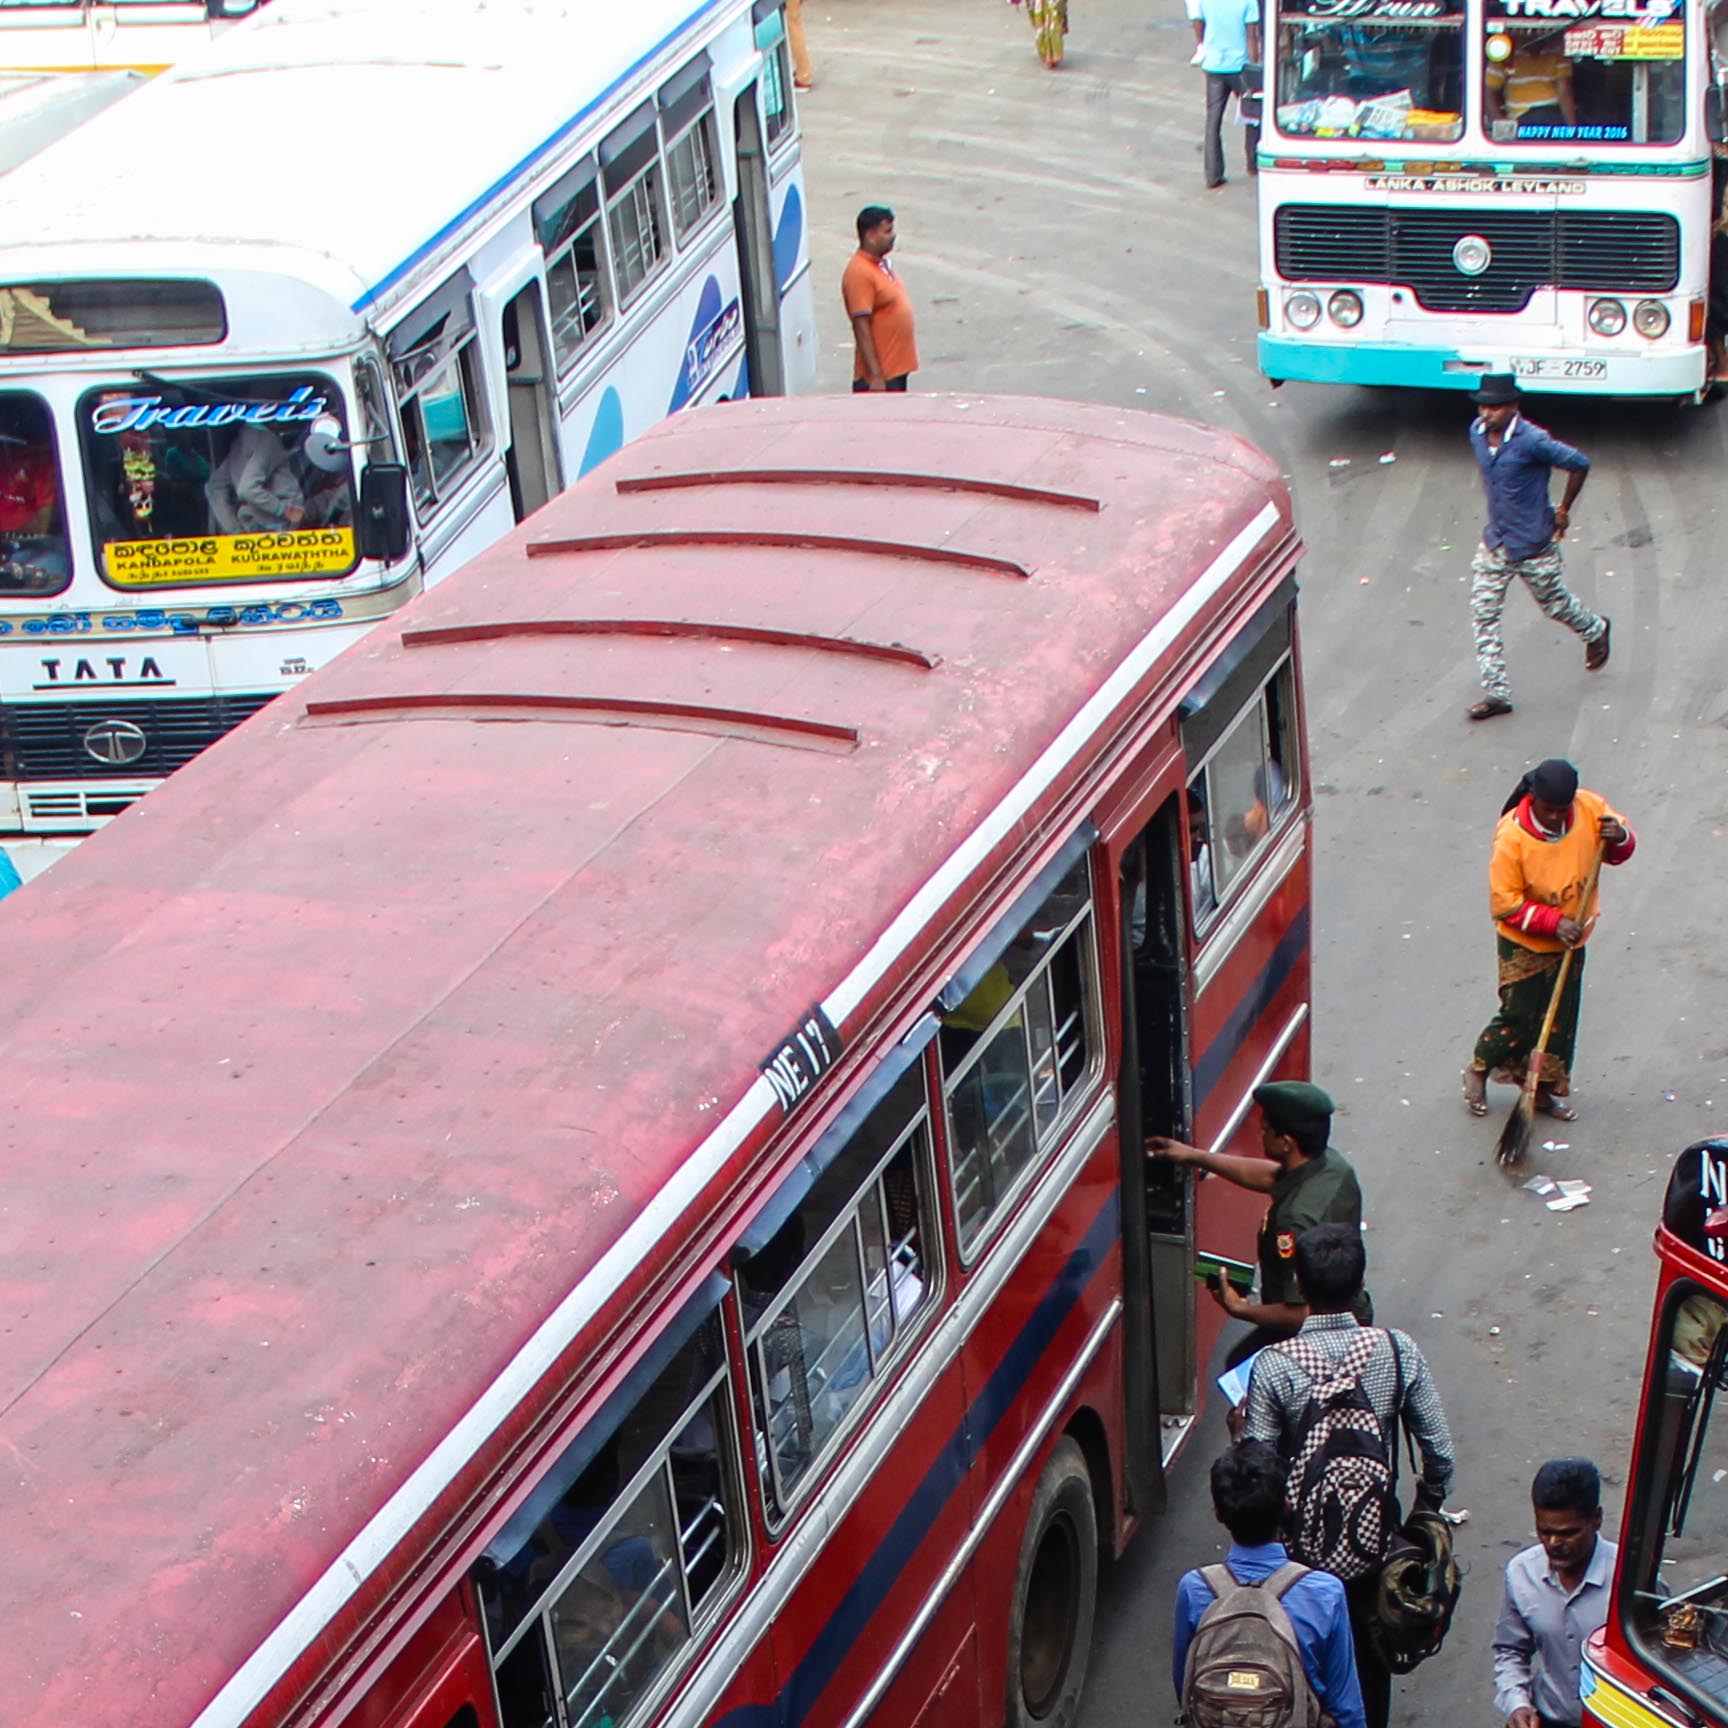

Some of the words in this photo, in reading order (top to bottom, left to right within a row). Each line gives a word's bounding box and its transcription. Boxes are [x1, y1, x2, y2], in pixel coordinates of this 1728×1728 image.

[1518, 126, 1549, 138] HAPPY
[1552, 126, 1574, 138] NEW
[1577, 126, 1602, 138] YEAR
[1604, 126, 1628, 138] 2016
[1365, 178, 1426, 192] LANKA
[1432, 179, 1495, 193] ASHOK
[1500, 179, 1585, 194] LEYLAND
[1564, 361, 1606, 377] 2759
[91, 385, 327, 434] Travels
[40, 656, 165, 681] TATA
[764, 1044, 810, 1113] NE
[796, 1018, 832, 1076] 17
